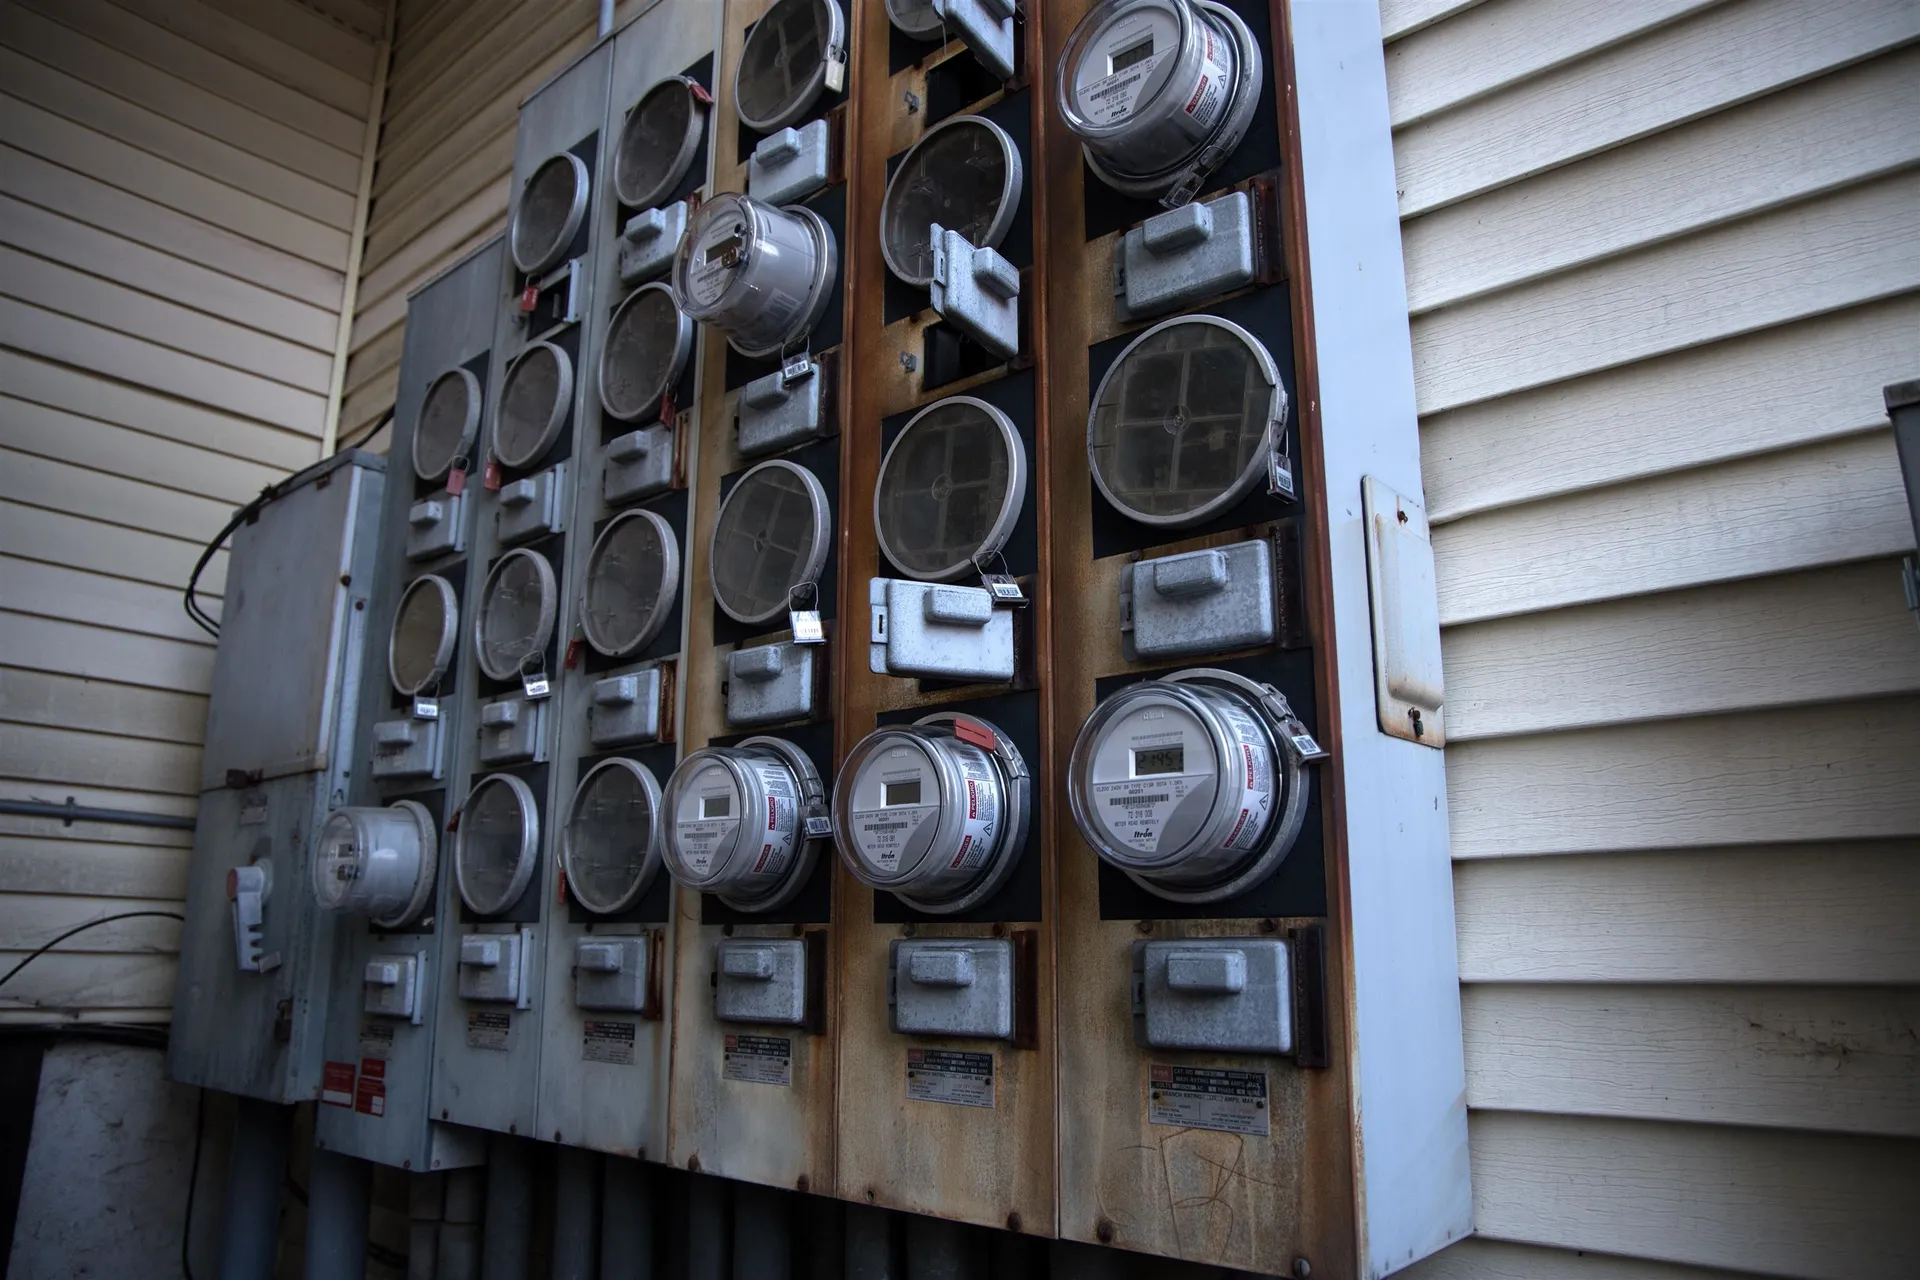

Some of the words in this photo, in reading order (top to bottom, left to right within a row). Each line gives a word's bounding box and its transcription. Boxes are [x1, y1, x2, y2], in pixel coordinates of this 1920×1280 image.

[1193, 77, 1208, 105] DANGER
[1245, 746, 1254, 781] PELIGRO
[1127, 811, 1134, 819] 72
[1133, 828, 1153, 838] Itron
[881, 850, 895, 859] Itron
[1184, 1092, 1202, 1100] RATING
